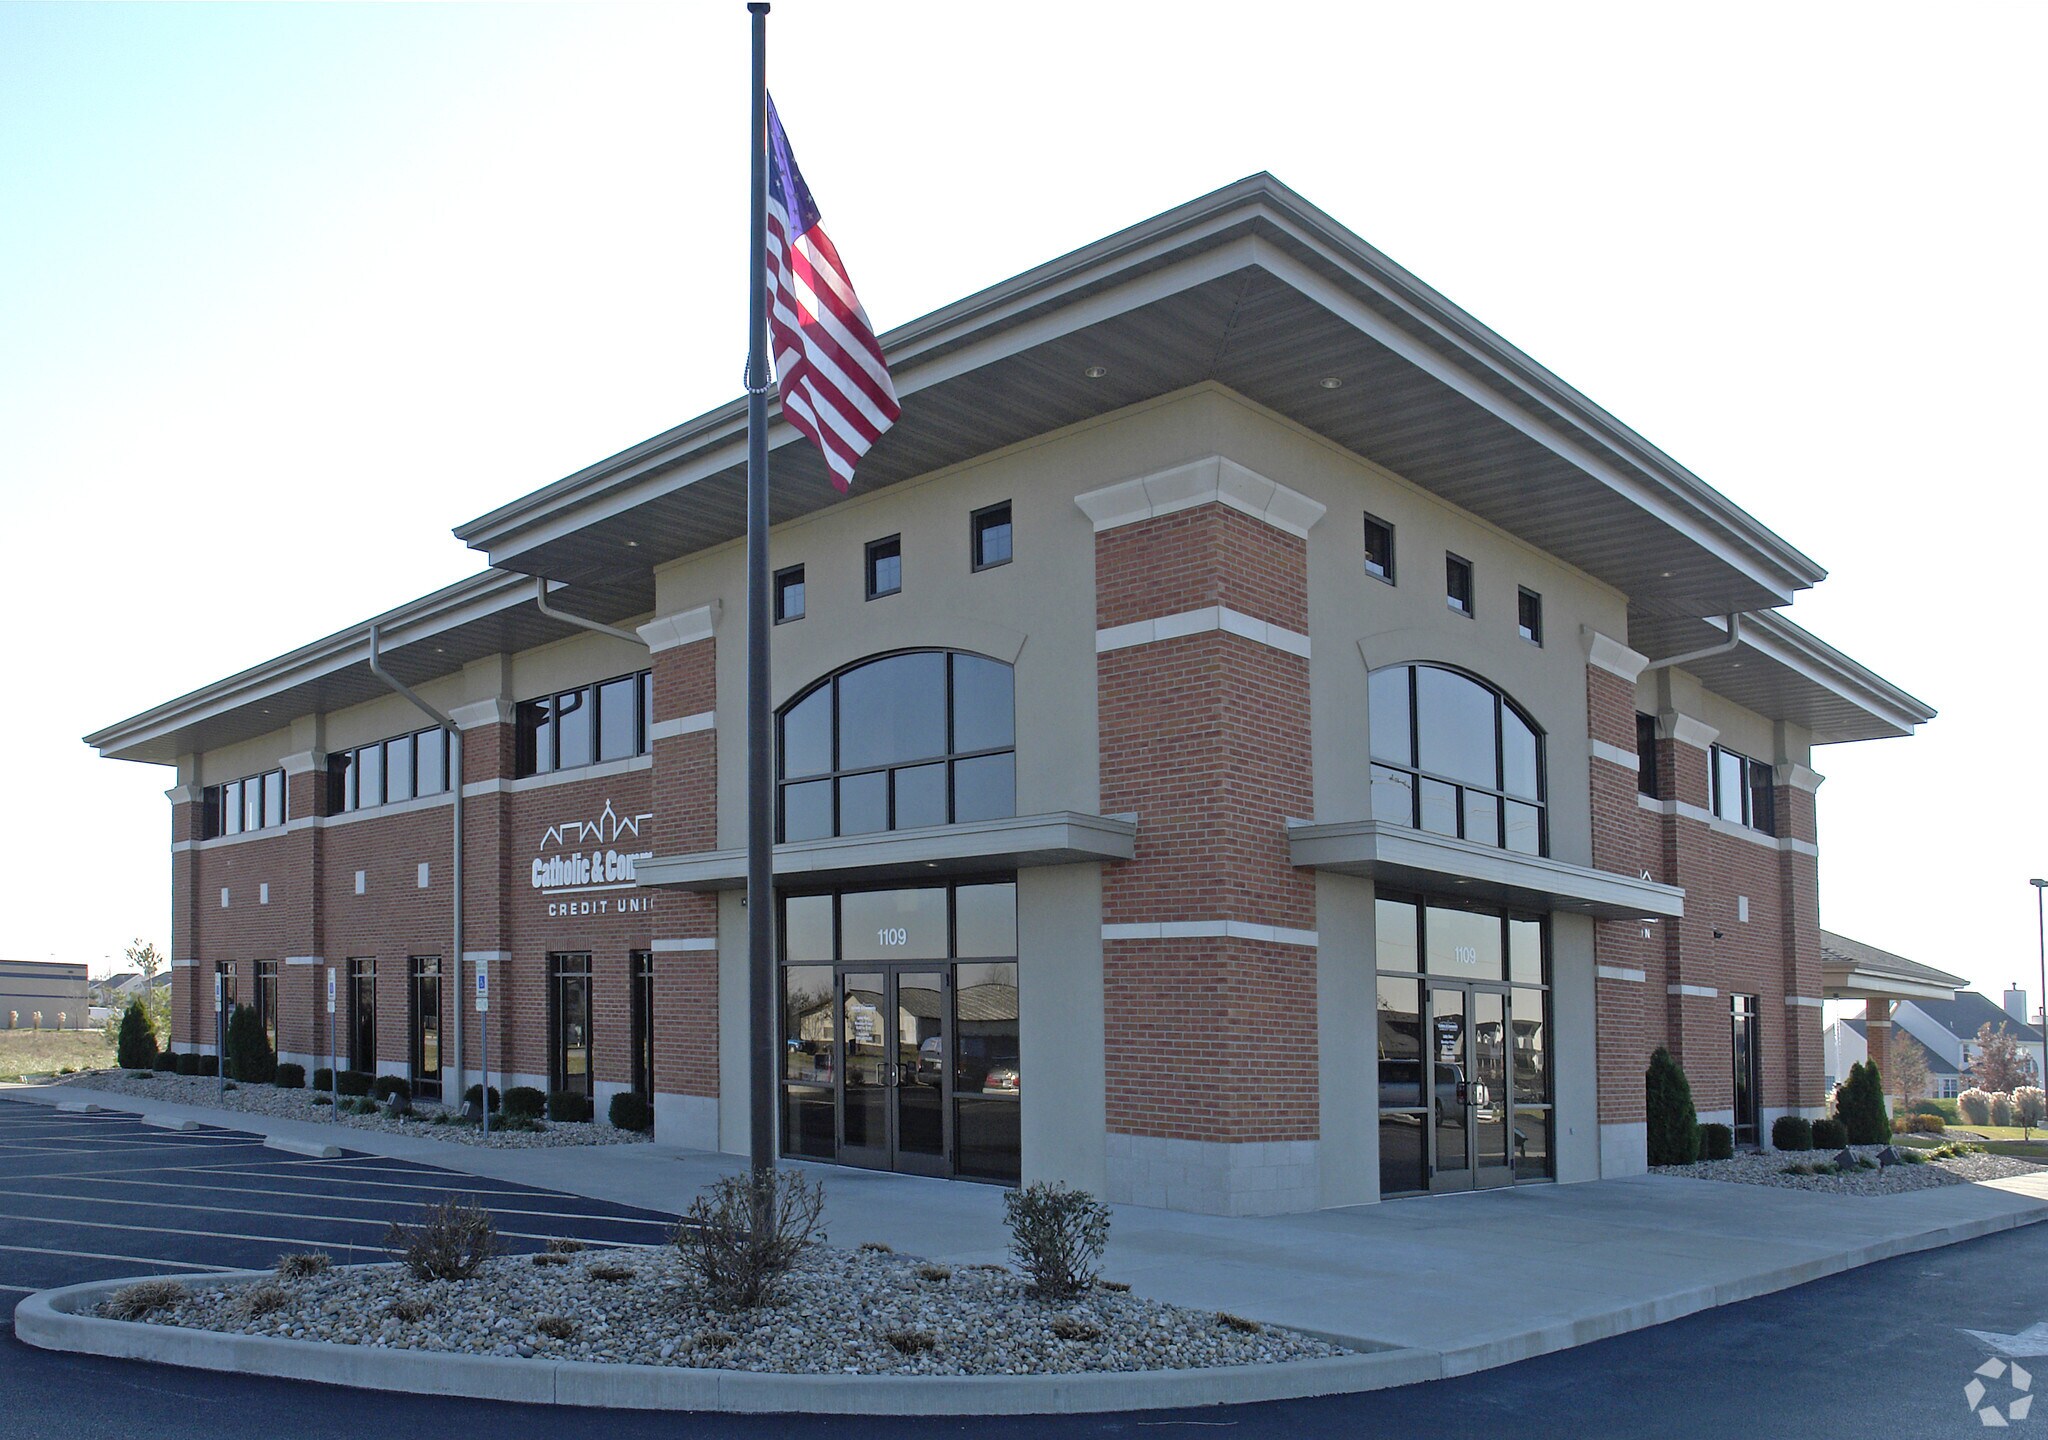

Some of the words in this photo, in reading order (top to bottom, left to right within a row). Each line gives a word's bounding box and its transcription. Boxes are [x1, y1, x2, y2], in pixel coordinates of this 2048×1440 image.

[532, 852, 590, 888] Catholic
[591, 851, 604, 883] &
[605, 850, 653, 881] Com
[549, 900, 608, 917] CREDIT
[617, 898, 654, 913] UNI
[877, 927, 907, 946] 1109
[1455, 946, 1476, 964] 1109
